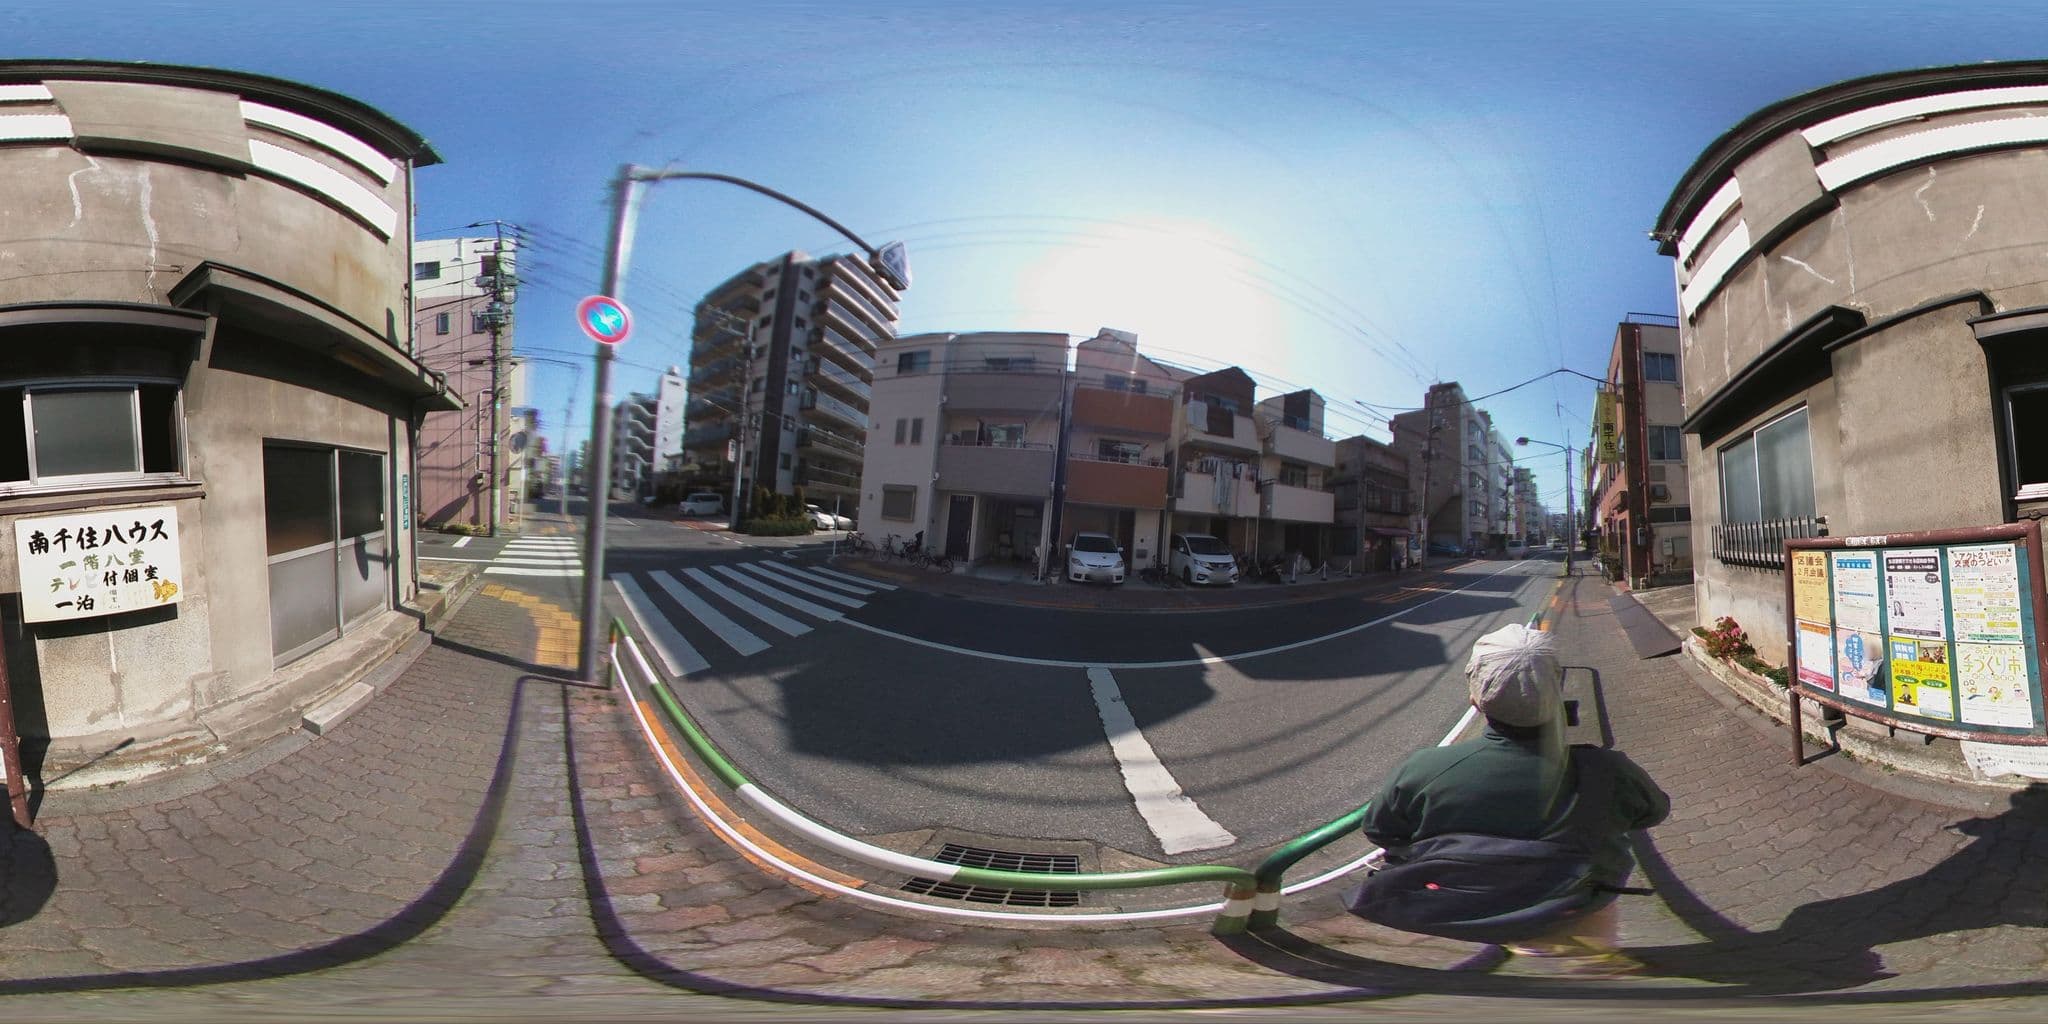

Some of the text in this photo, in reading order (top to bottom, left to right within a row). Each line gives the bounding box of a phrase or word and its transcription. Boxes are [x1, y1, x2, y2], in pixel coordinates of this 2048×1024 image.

[1603, 422, 1616, 450] 南千住
[28, 519, 168, 555] 南千住ハウス
[58, 548, 145, 572] 一階八室
[1798, 555, 1824, 567] 区議会
[55, 594, 95, 611] 一泊
